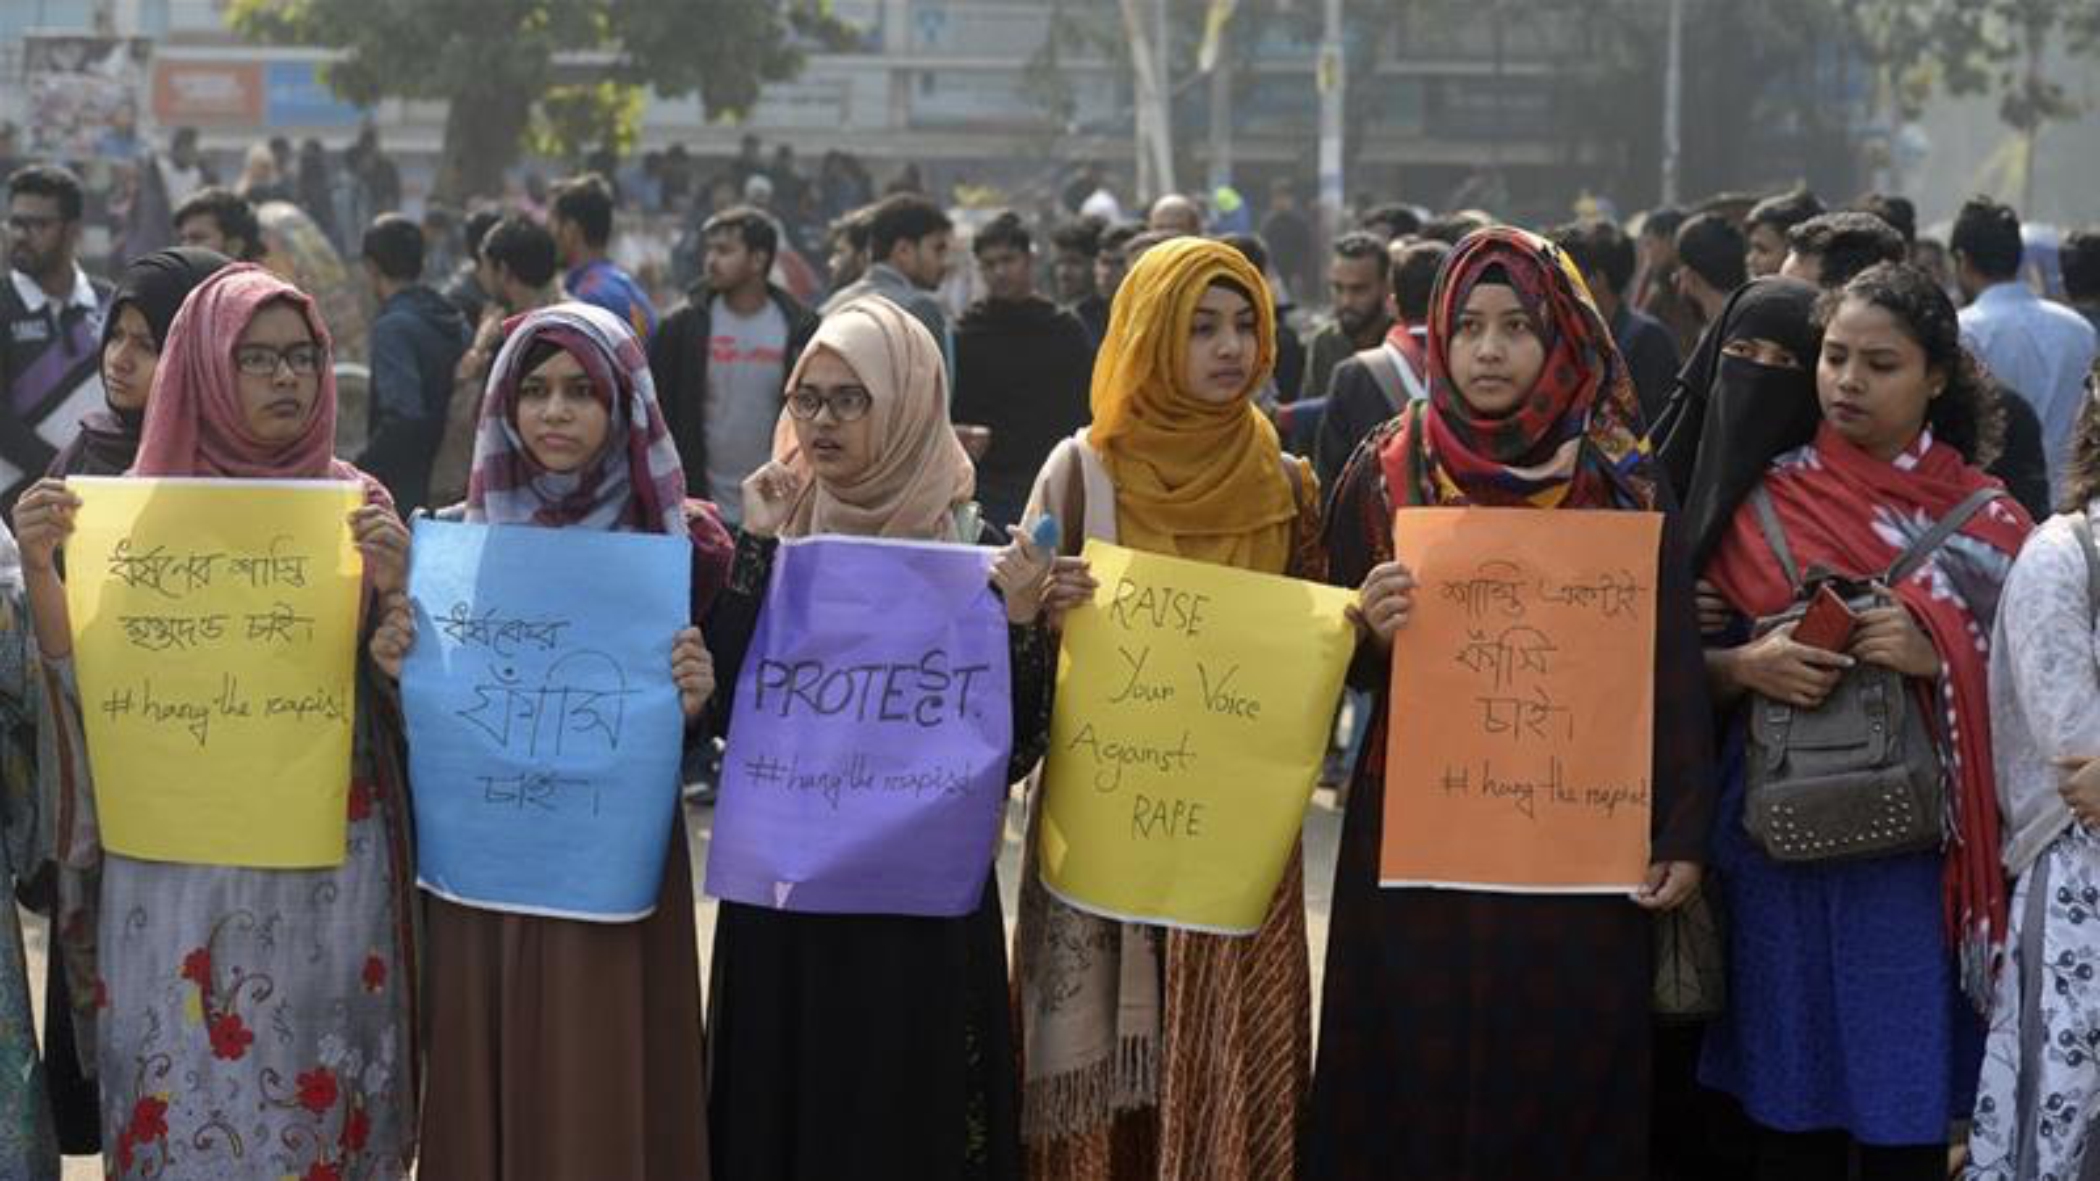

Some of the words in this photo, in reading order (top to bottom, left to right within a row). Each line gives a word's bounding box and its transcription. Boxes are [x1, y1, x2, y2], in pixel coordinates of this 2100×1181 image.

[1110, 577, 1211, 636] RAISE
[1196, 661, 1262, 721] Voice
[1132, 794, 1206, 840] RAPE
